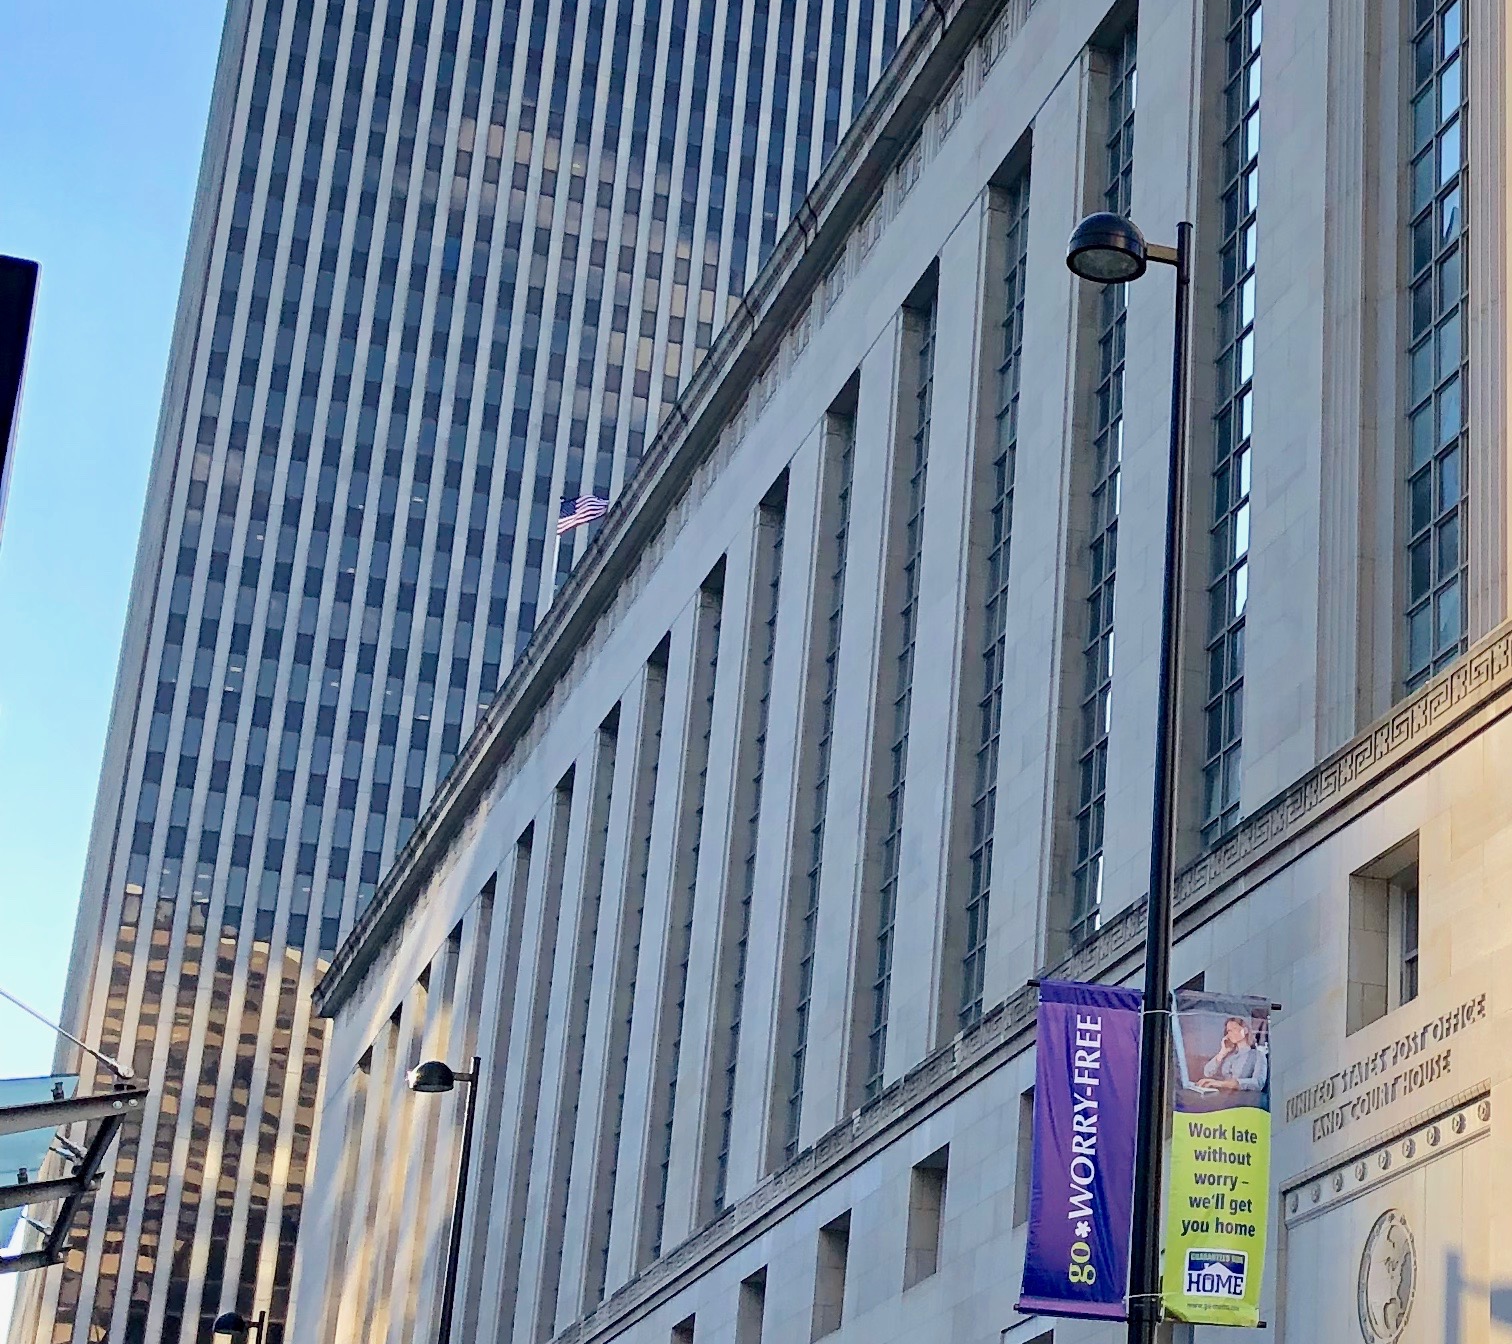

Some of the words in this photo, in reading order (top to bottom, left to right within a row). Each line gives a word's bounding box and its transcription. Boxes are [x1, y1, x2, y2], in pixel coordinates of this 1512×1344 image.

[1286, 1073, 1341, 1123] UNITED
[1341, 1046, 1391, 1094] STATES
[1392, 1021, 1433, 1066] POST
[1432, 993, 1487, 1042] OFFICE
[1312, 1101, 1352, 1143] AND
[1350, 1076, 1402, 1121] COURT
[1402, 1049, 1452, 1096] HOUSE
[1067, 1013, 1102, 1220] WORRY-FREE
[1188, 1121, 1228, 1140] Work
[1231, 1125, 1258, 1144] late
[1193, 1146, 1252, 1167] without
[1193, 1171, 1238, 1192] worry
[1229, 1198, 1253, 1216] get
[1180, 1218, 1210, 1237] you
[1214, 1217, 1256, 1237] home
[1068, 1241, 1097, 1286] go
[1186, 1272, 1244, 1296] HOME
